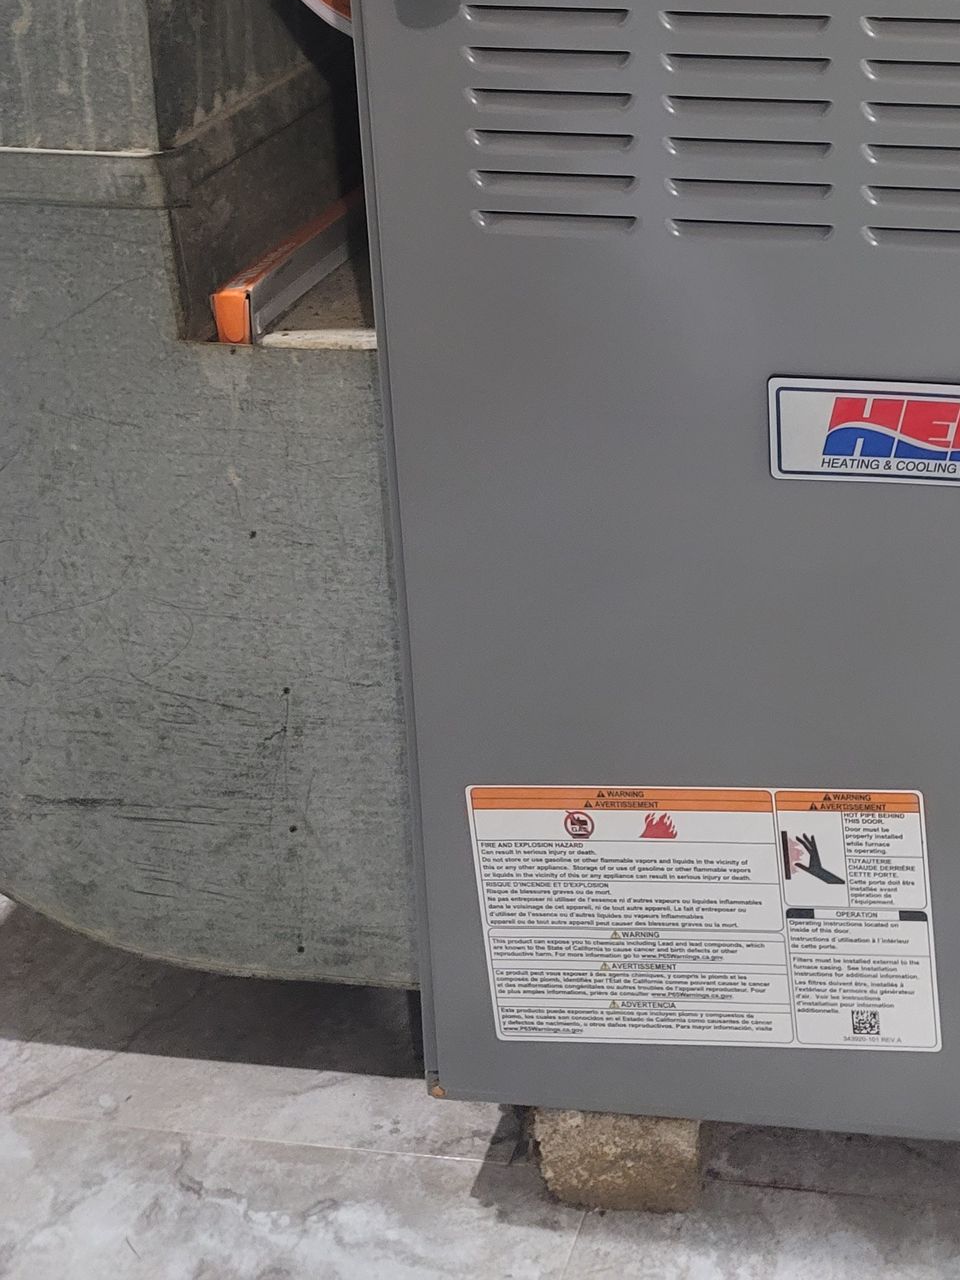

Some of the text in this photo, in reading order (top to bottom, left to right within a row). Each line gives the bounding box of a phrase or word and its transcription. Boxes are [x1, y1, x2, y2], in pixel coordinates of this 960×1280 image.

[821, 457, 881, 470] HEATING
[883, 460, 892, 471] &
[896, 460, 957, 475] COOLING
[607, 790, 644, 798] WARNING
[846, 833, 872, 841] properly
